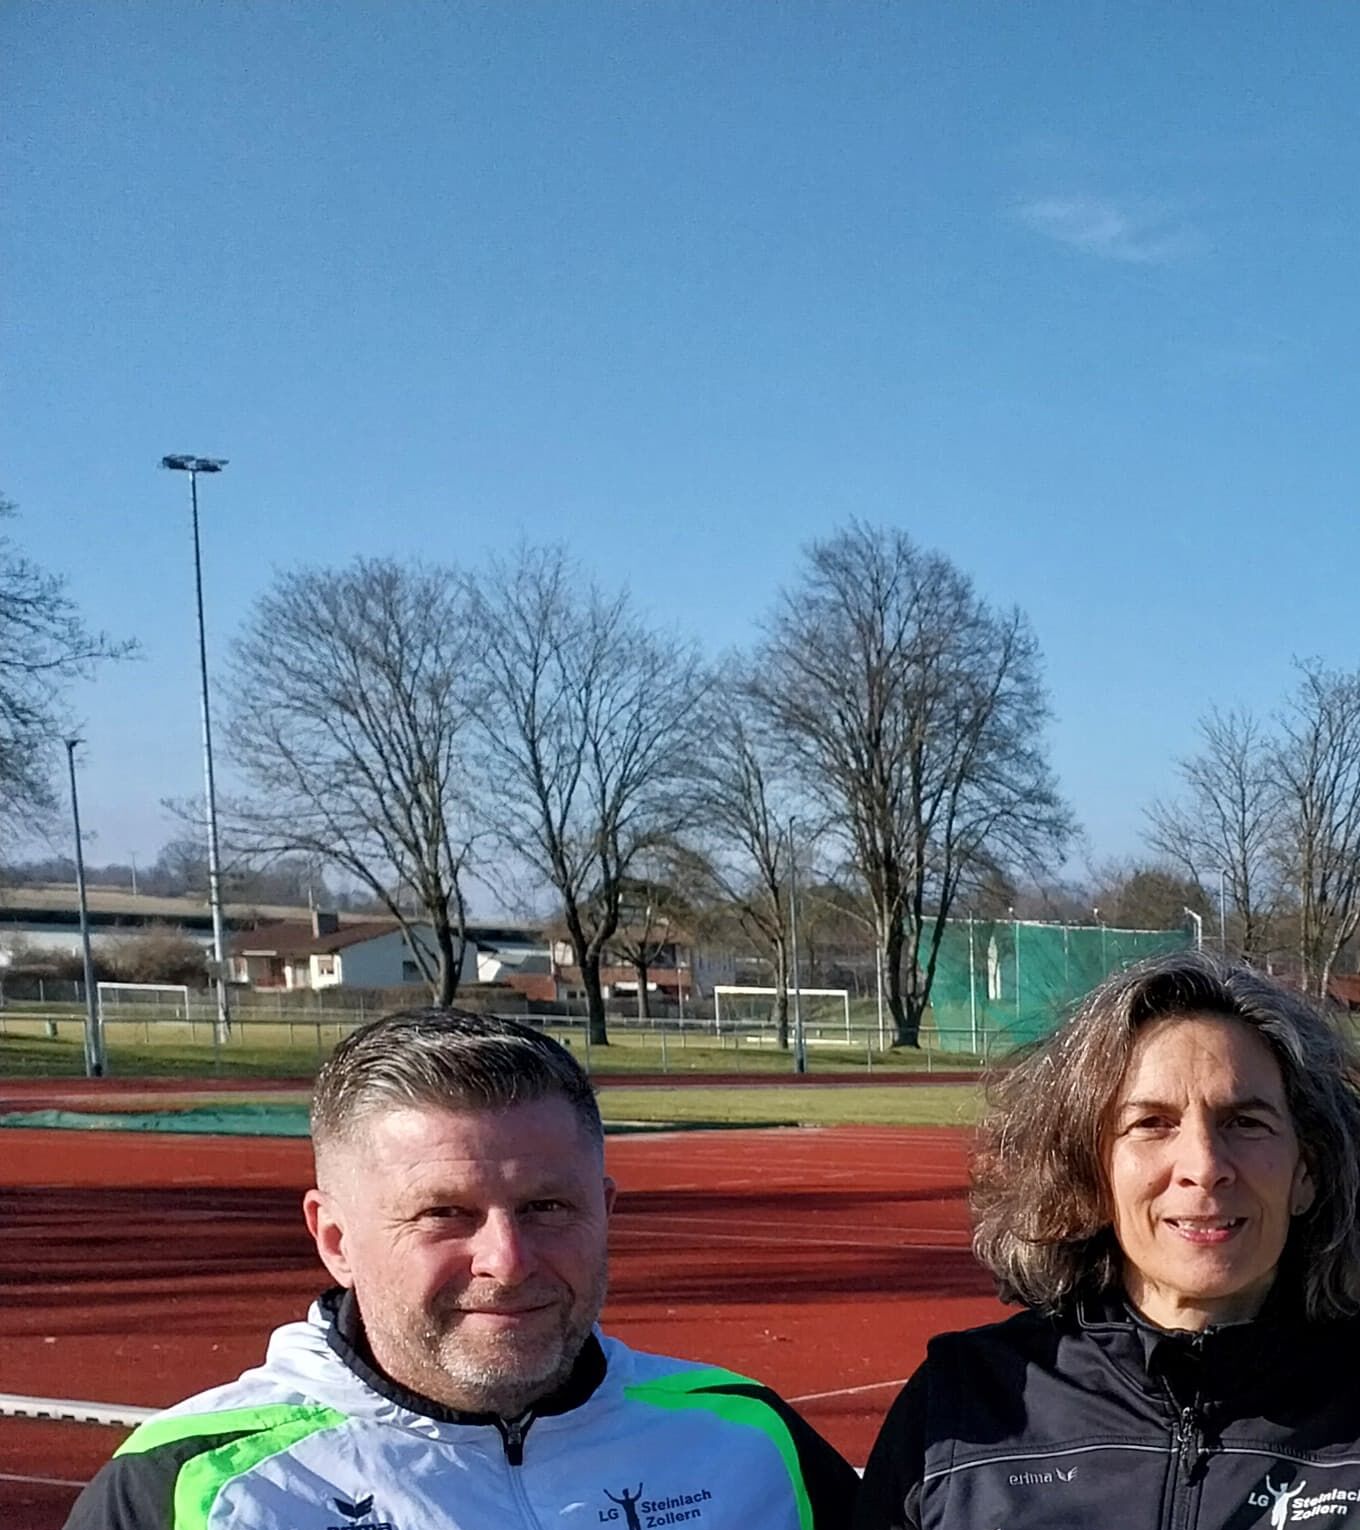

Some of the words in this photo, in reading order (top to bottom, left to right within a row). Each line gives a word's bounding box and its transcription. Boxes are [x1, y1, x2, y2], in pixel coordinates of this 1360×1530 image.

[1009, 1471, 1053, 1486] erima
[598, 1508, 619, 1522] LG
[641, 1489, 713, 1514] Steinlach
[1248, 1492, 1270, 1507] LG
[646, 1508, 702, 1529] Zollern
[1291, 1504, 1348, 1521] Zollern
